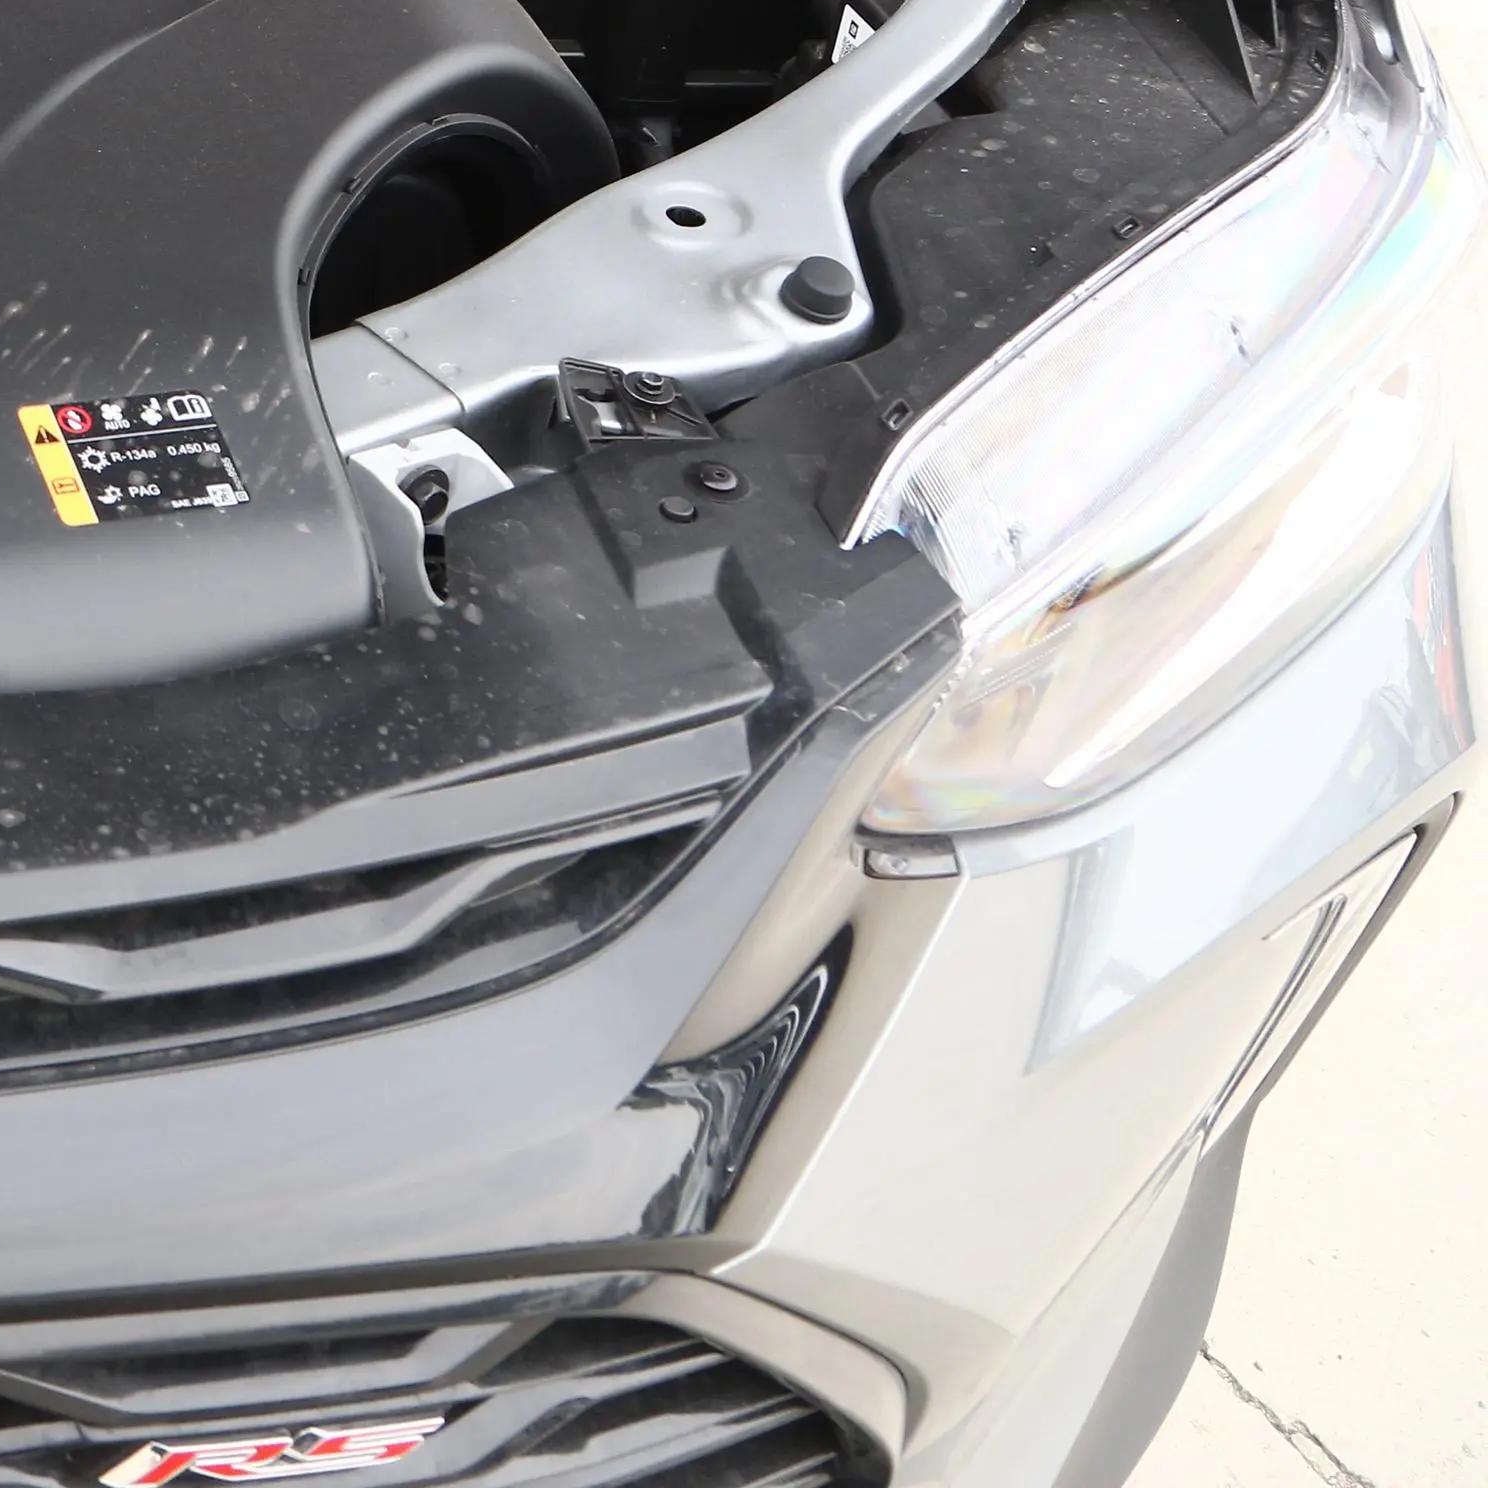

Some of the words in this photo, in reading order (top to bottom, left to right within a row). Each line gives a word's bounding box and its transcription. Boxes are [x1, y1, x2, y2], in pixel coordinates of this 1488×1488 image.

[104, 419, 130, 431] AUTO
[110, 448, 157, 463] R-134a
[166, 442, 202, 456] 0.450
[203, 441, 221, 453] kg
[127, 483, 161, 498] PAG
[99, 1415, 445, 1488] RS
